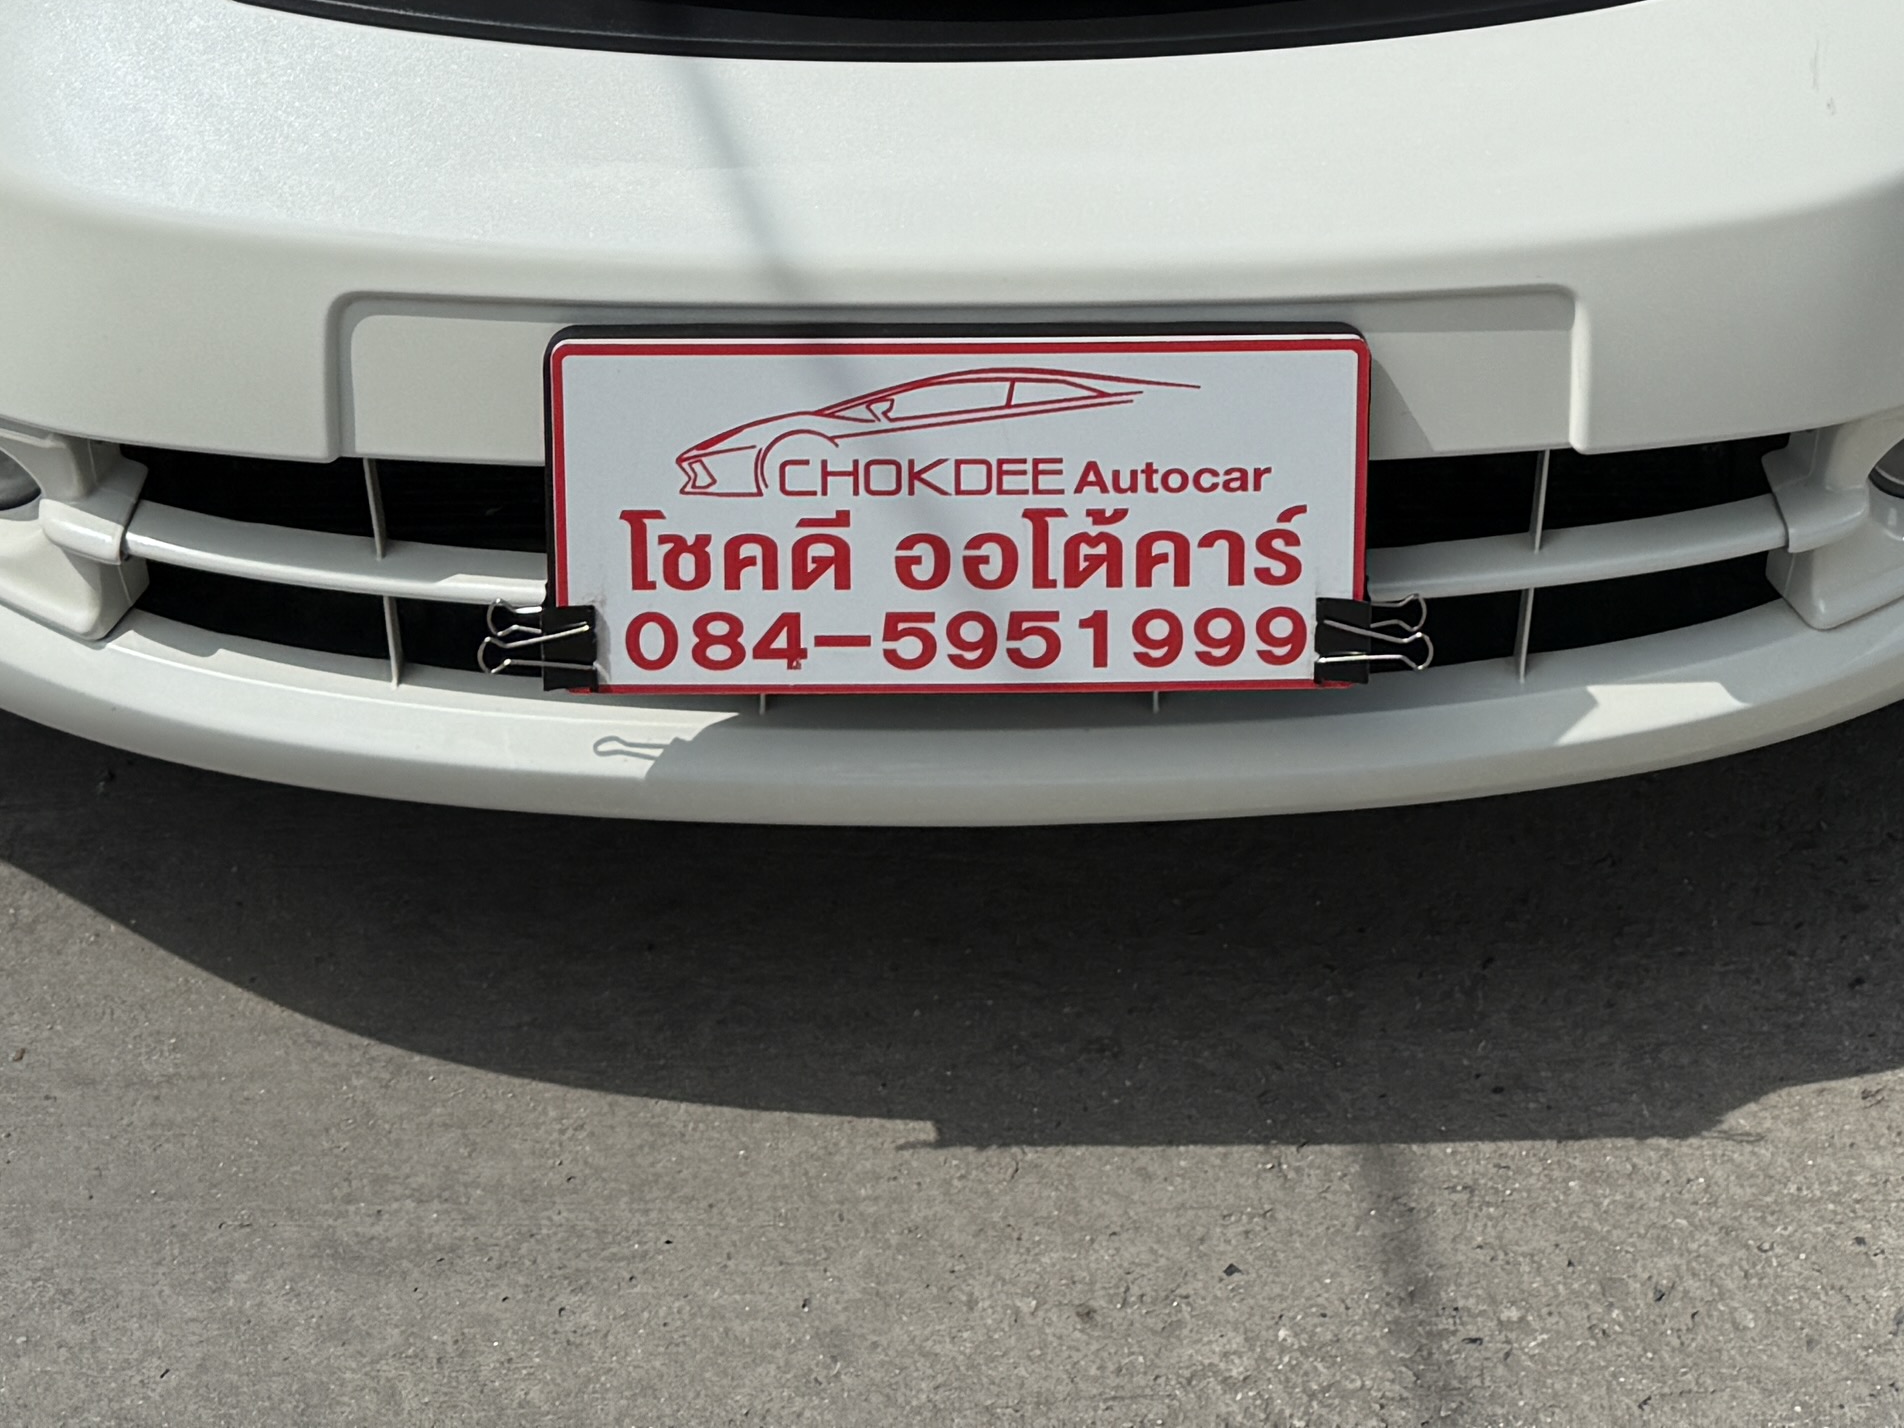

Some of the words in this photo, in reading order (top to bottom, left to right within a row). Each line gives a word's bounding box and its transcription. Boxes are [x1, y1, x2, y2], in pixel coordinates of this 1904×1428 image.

[778, 457, 1065, 497] CHOKDEE
[1073, 460, 1272, 495] Autocar
[619, 508, 853, 591] โชคดี
[895, 504, 1308, 590] ออโต้คาร์
[624, 607, 1310, 672] 084-5951999
